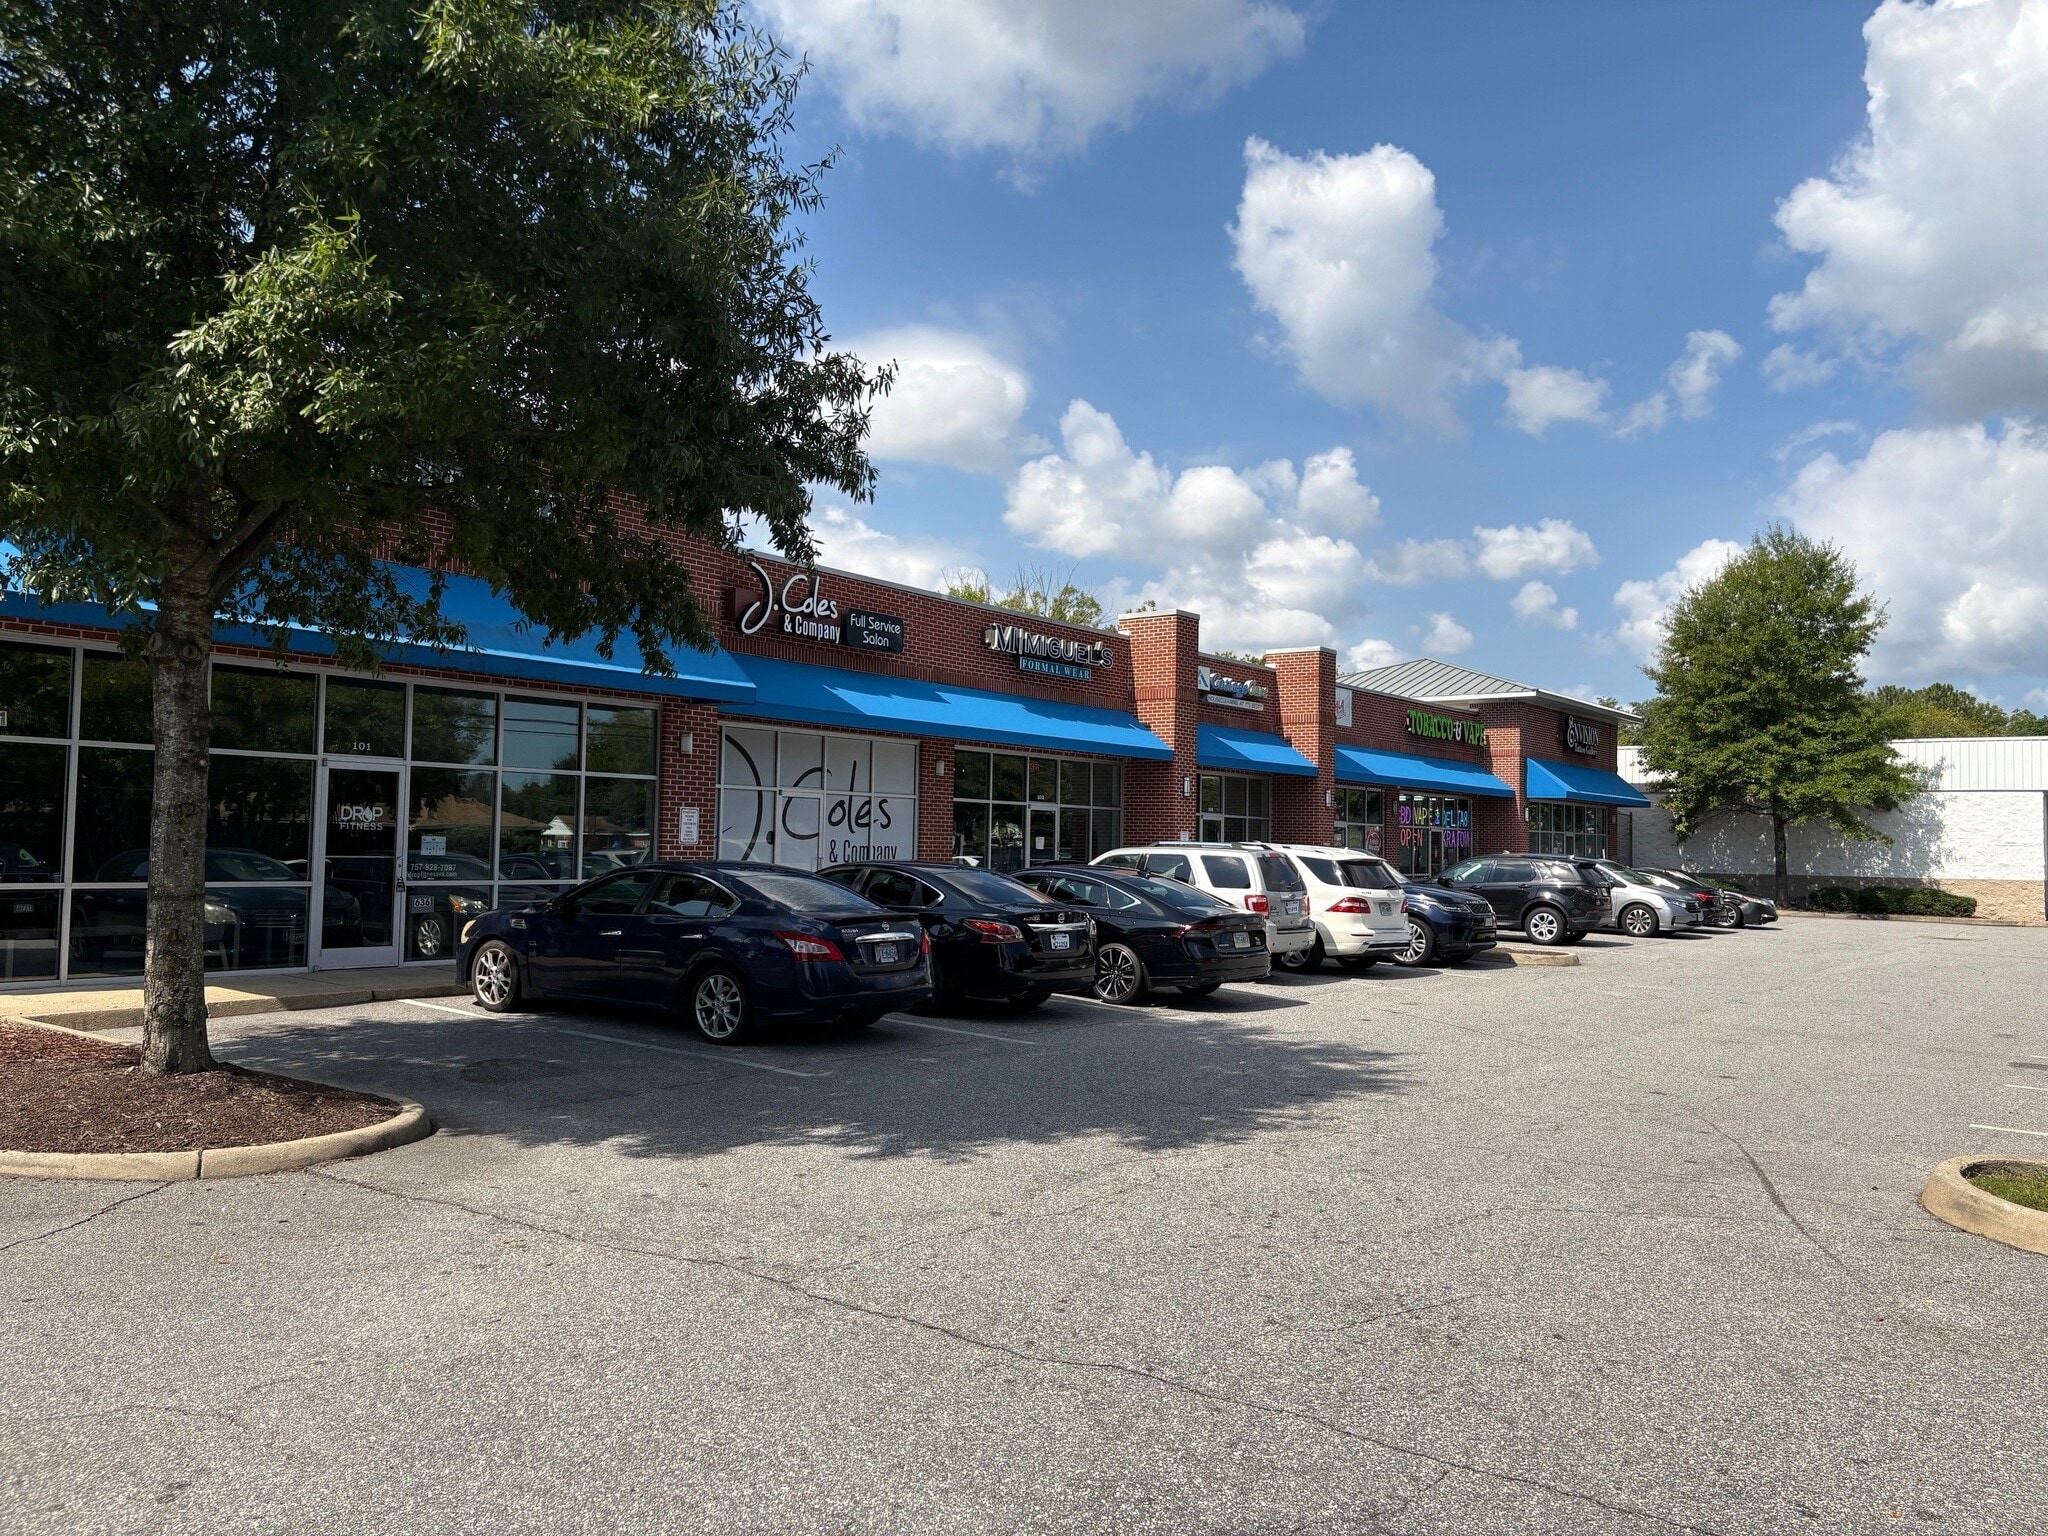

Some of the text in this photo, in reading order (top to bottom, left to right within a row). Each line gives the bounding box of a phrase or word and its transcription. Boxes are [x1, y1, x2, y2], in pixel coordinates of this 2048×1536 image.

[782, 574, 838, 619] Coles
[784, 614, 841, 644] & Company
[850, 613, 901, 634] Full Service
[863, 632, 889, 647] Salon
[1024, 631, 1113, 669] MIGUEL'S
[1022, 659, 1090, 679] FORMAL WEAR
[1408, 708, 1454, 740] TOBACCO
[1462, 720, 1487, 747] VAPE
[352, 742, 371, 751] 101
[781, 759, 891, 840] Coles
[340, 805, 384, 823] DROP
[339, 821, 383, 831] FITNESS
[829, 839, 838, 863] &
